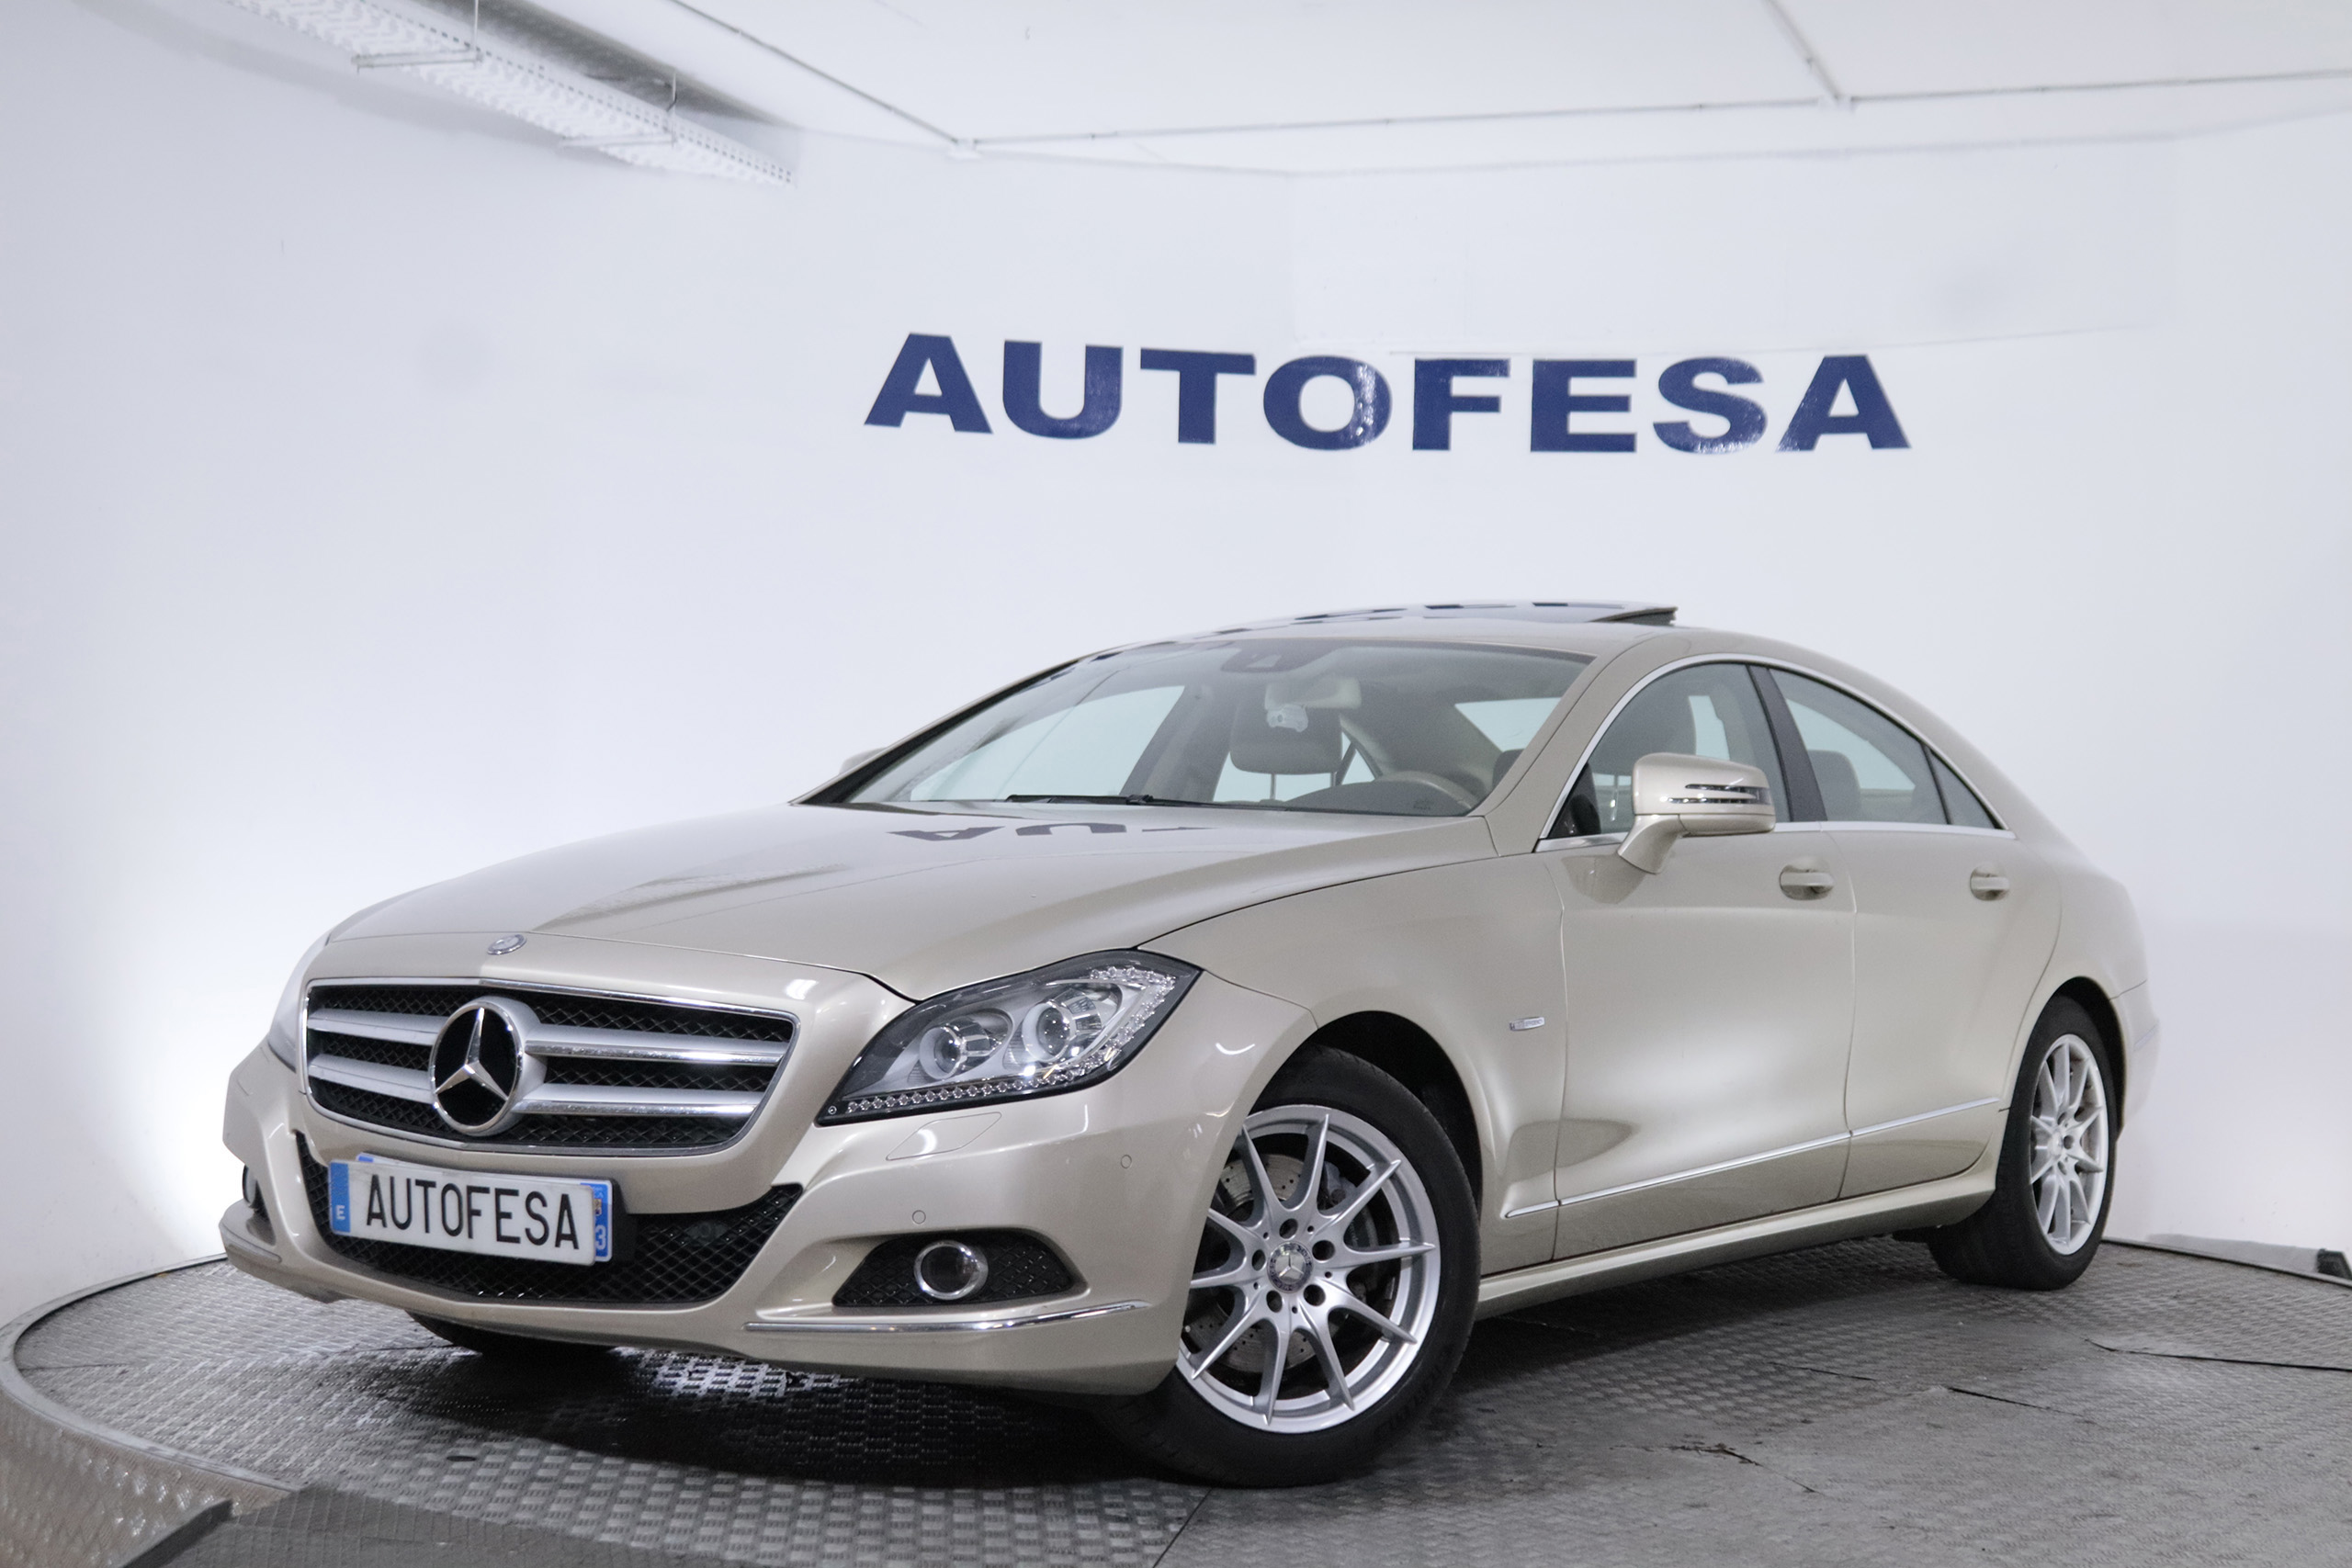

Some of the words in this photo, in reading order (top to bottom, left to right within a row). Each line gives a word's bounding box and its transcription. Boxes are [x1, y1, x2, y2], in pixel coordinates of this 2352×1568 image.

[864, 333, 1911, 454] AUTOFESA
[335, 1204, 346, 1221] E
[367, 1173, 580, 1250] AUTOFESA
